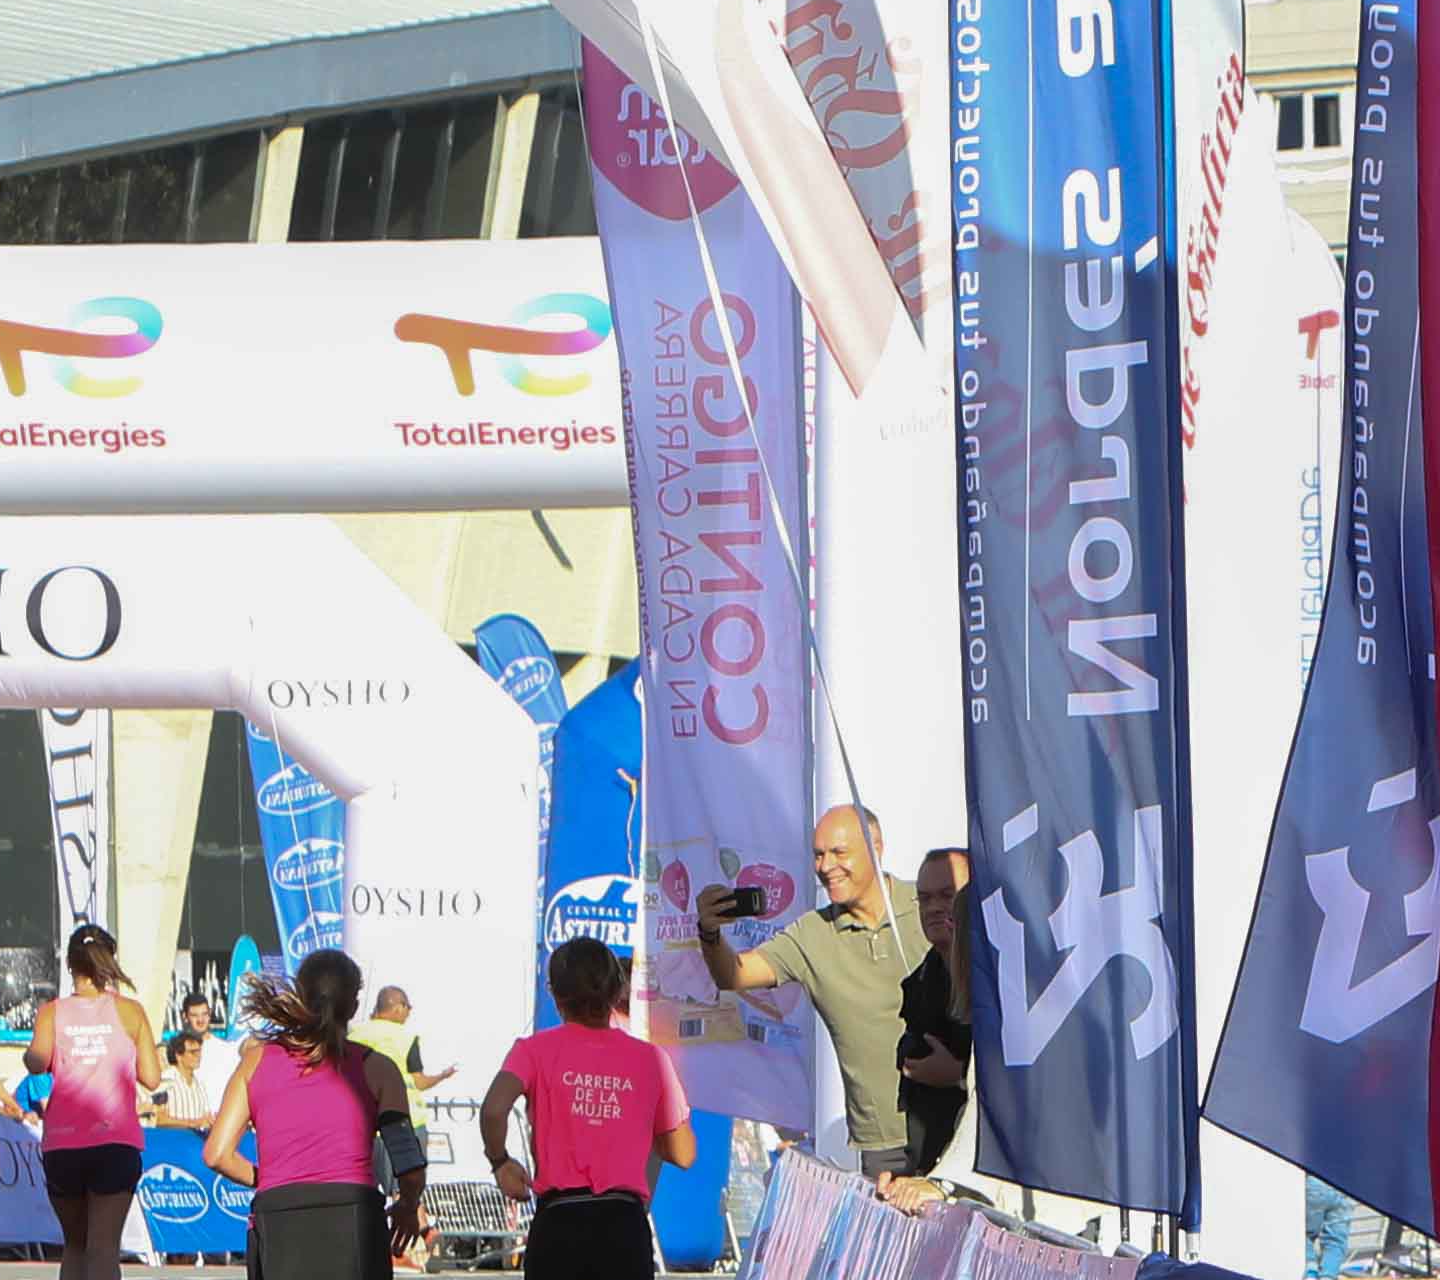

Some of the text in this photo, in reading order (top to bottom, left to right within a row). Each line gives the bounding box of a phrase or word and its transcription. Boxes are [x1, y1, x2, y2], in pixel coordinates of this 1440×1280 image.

[395, 421, 616, 453] TotalEnergies
[562, 1070, 634, 1091] CARRERA
[575, 1088, 619, 1105] DE LA
[571, 1101, 622, 1120] MUJER
